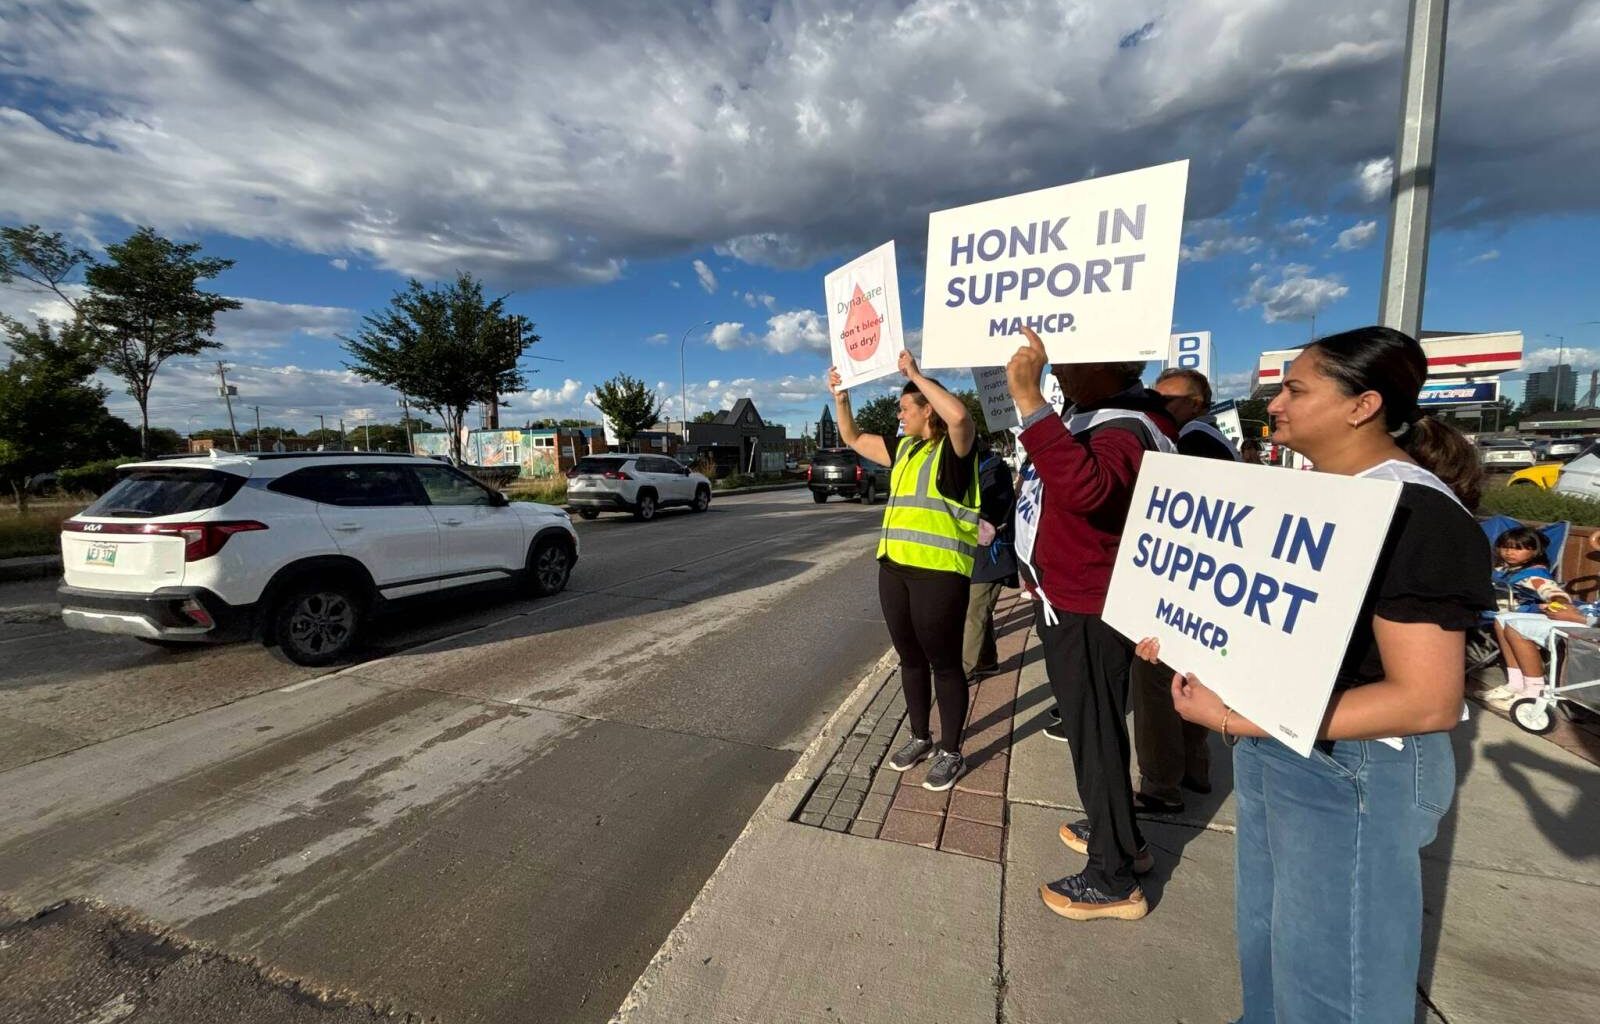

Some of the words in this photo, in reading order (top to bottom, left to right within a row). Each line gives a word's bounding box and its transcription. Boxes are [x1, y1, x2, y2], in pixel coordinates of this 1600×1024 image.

[950, 216, 1072, 267] HONK
[1096, 203, 1147, 246] IN
[945, 254, 1145, 309] SUPPORT
[837, 286, 882, 314] Dynacare
[840, 325, 861, 340] don't
[862, 313, 884, 331] bleed
[849, 342, 859, 351] us
[860, 332, 877, 346] dry!
[988, 392, 1004, 405] And
[990, 408, 1003, 417] do
[1145, 485, 1256, 549] HONK
[1271, 513, 1337, 572] IN
[1132, 533, 1319, 635] SUPPORT
